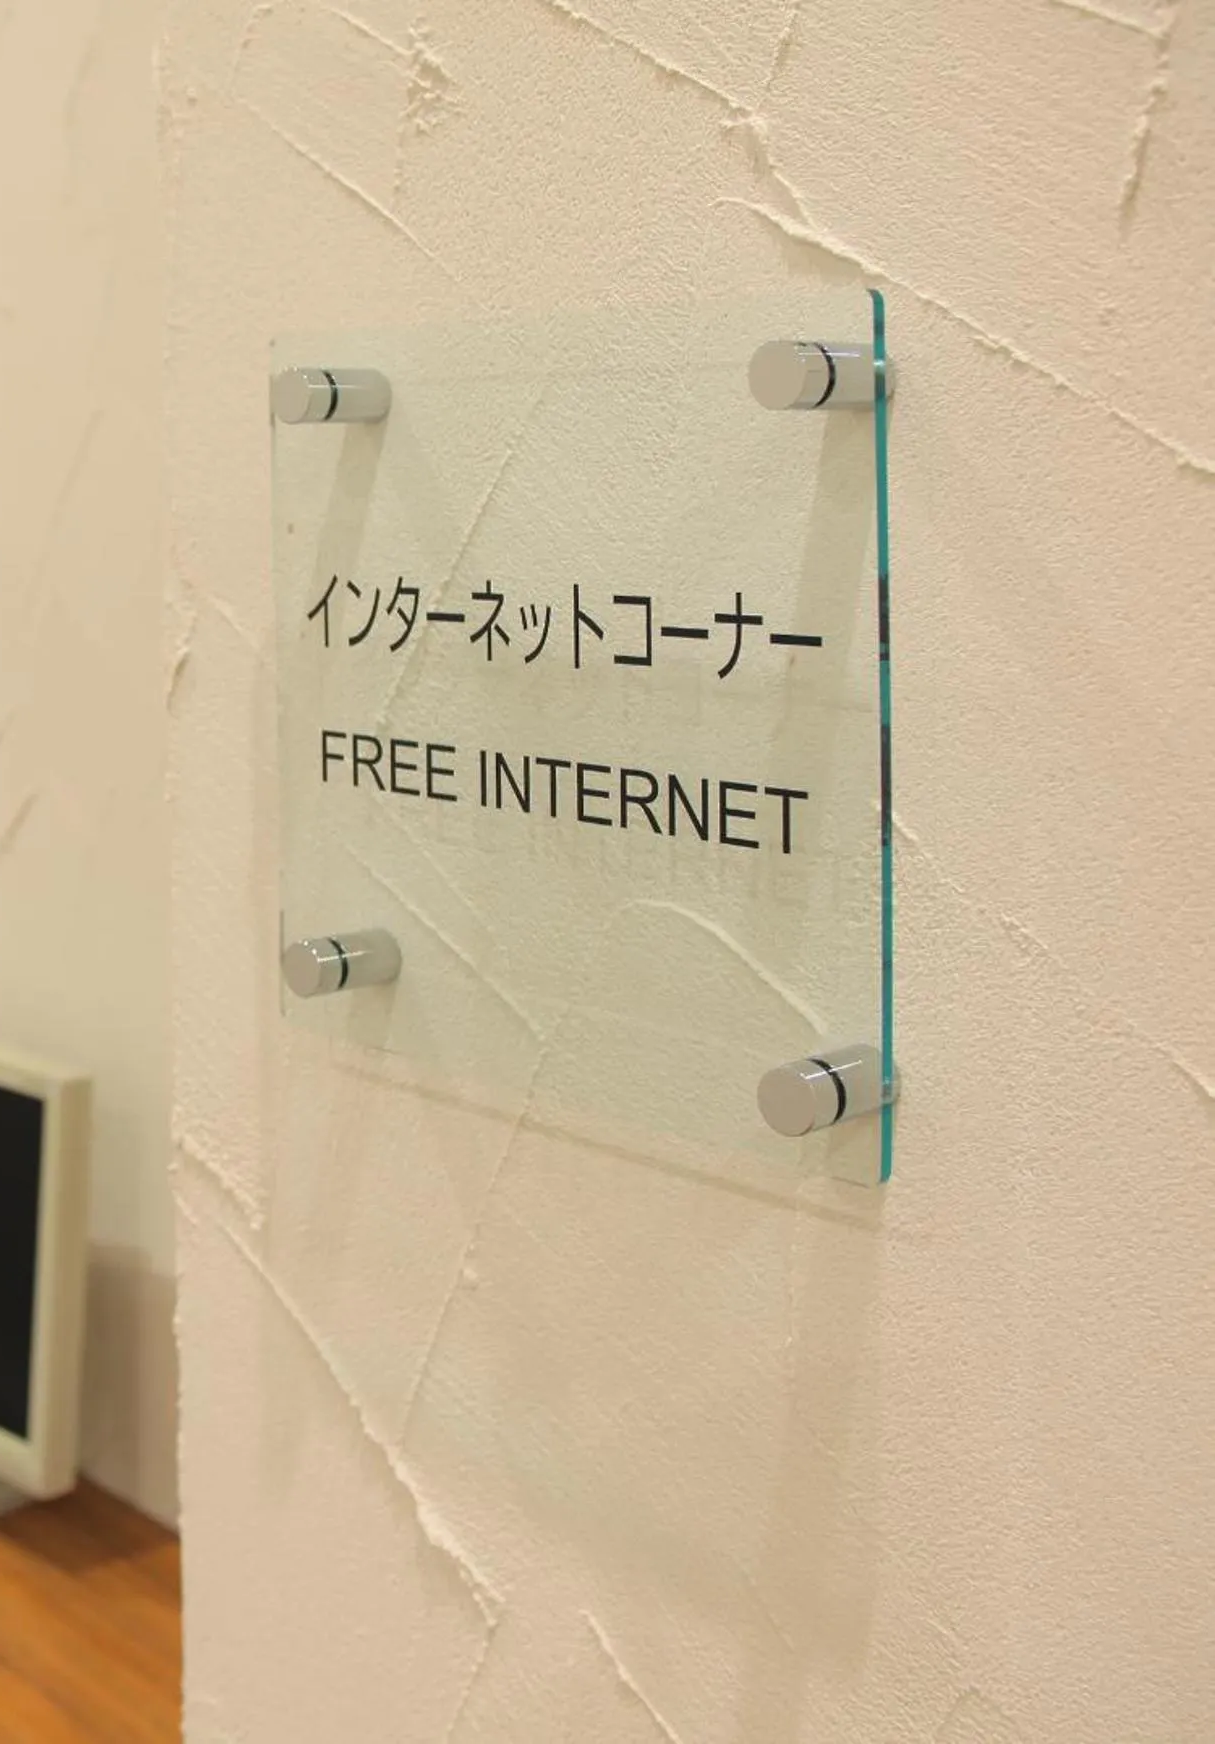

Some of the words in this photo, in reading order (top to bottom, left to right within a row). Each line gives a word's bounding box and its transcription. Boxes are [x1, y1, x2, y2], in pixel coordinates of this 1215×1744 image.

[307, 574, 823, 680] インターネットコーナー
[321, 729, 458, 802] FREE
[478, 749, 809, 855] INTERNET
